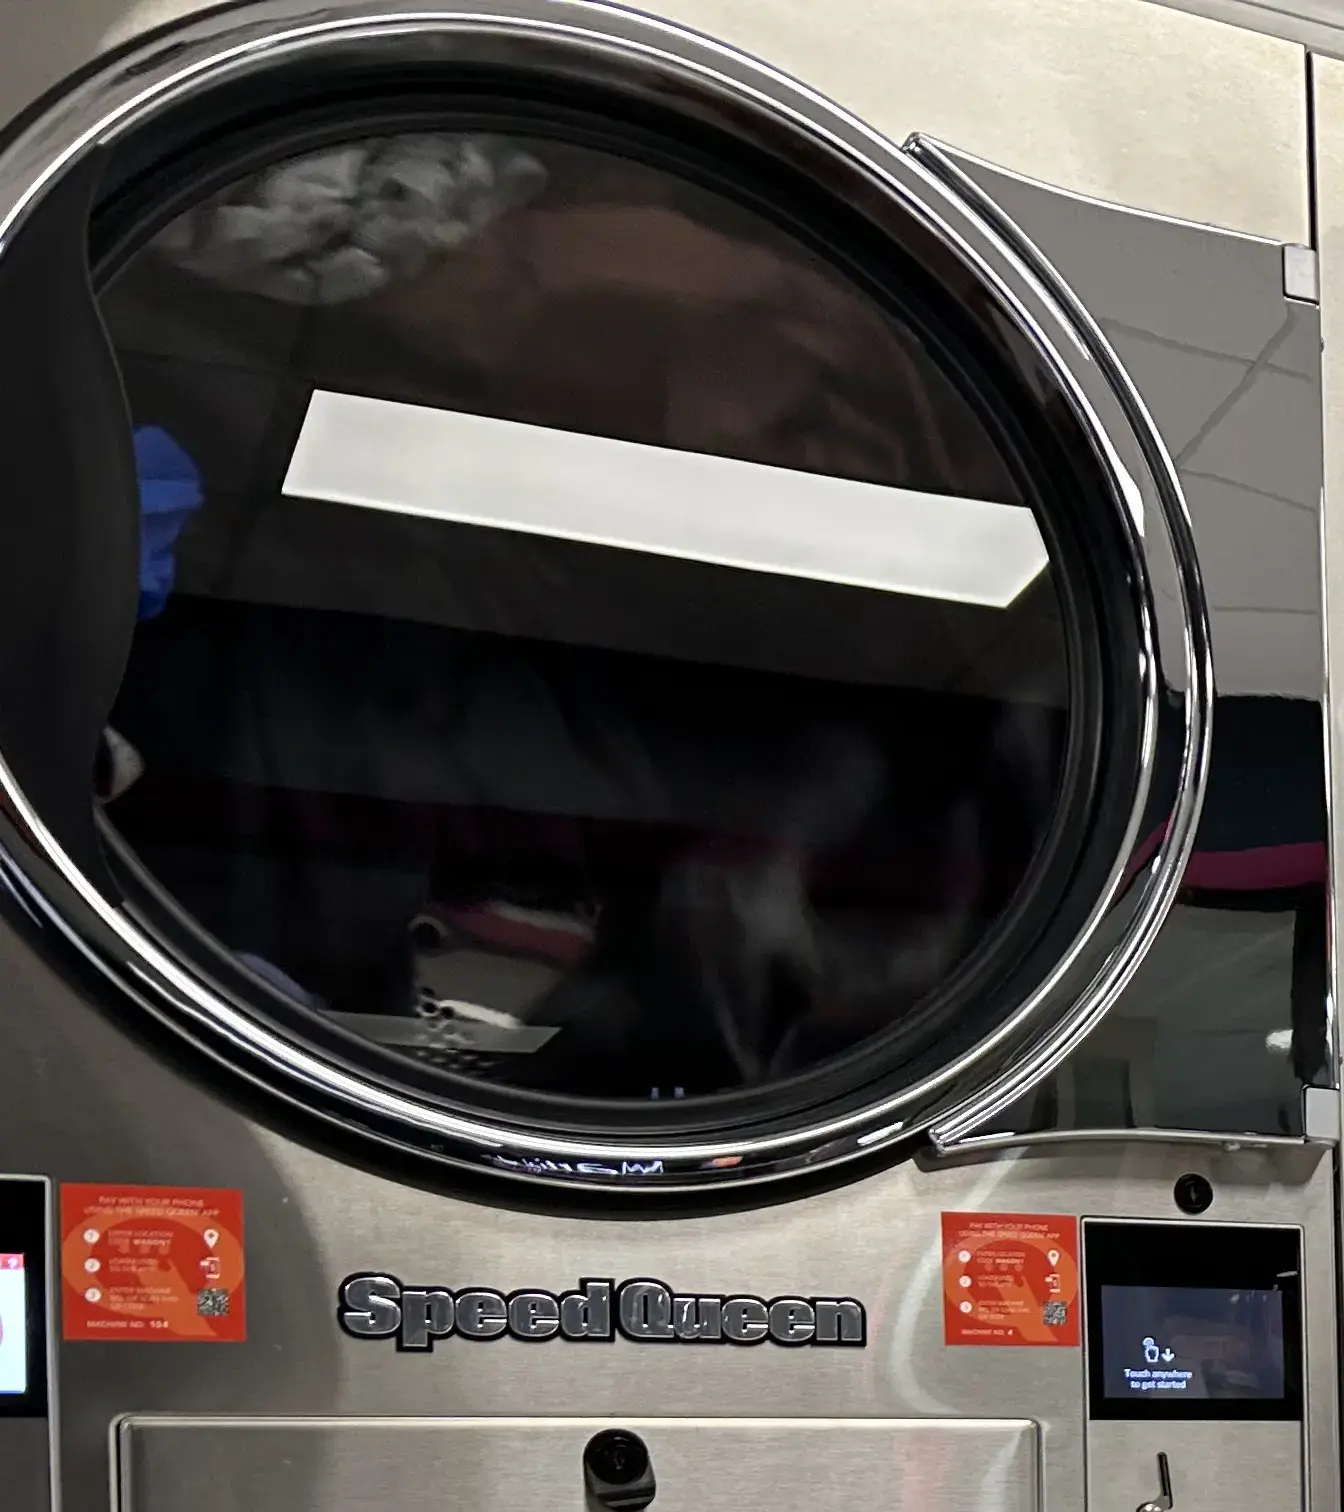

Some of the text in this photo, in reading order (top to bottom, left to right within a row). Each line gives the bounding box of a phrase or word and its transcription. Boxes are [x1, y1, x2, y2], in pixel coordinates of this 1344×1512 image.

[338, 1271, 866, 1351] Speed Queen
[1124, 1369, 1193, 1379] Touch anywhere
[1130, 1380, 1187, 1390] to get started
